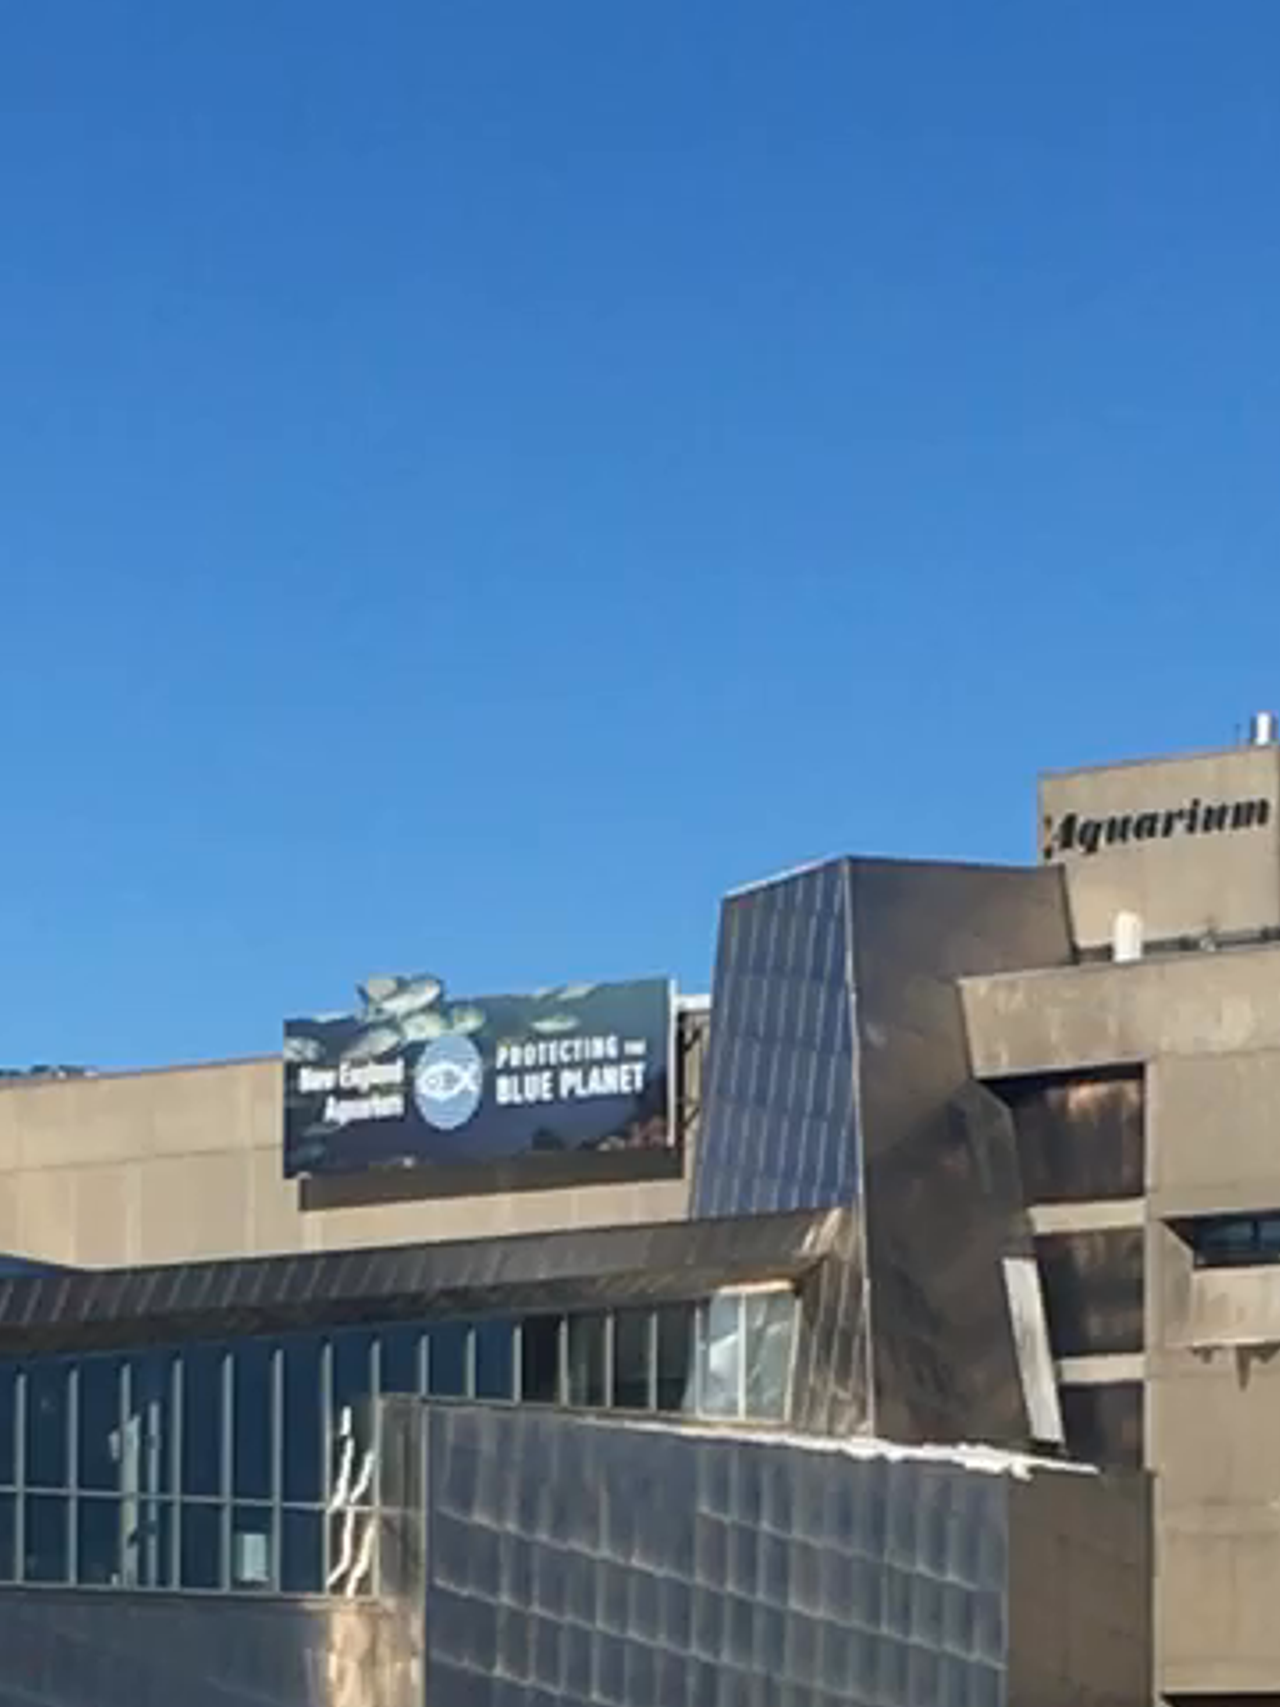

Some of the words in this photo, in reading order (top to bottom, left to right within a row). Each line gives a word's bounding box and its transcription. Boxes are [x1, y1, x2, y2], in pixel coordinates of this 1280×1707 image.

[1053, 797, 1269, 854] Aquarium
[496, 1034, 618, 1069] PROTECTING
[496, 1070, 553, 1105] BLUE
[560, 1062, 645, 1100] PLANET
